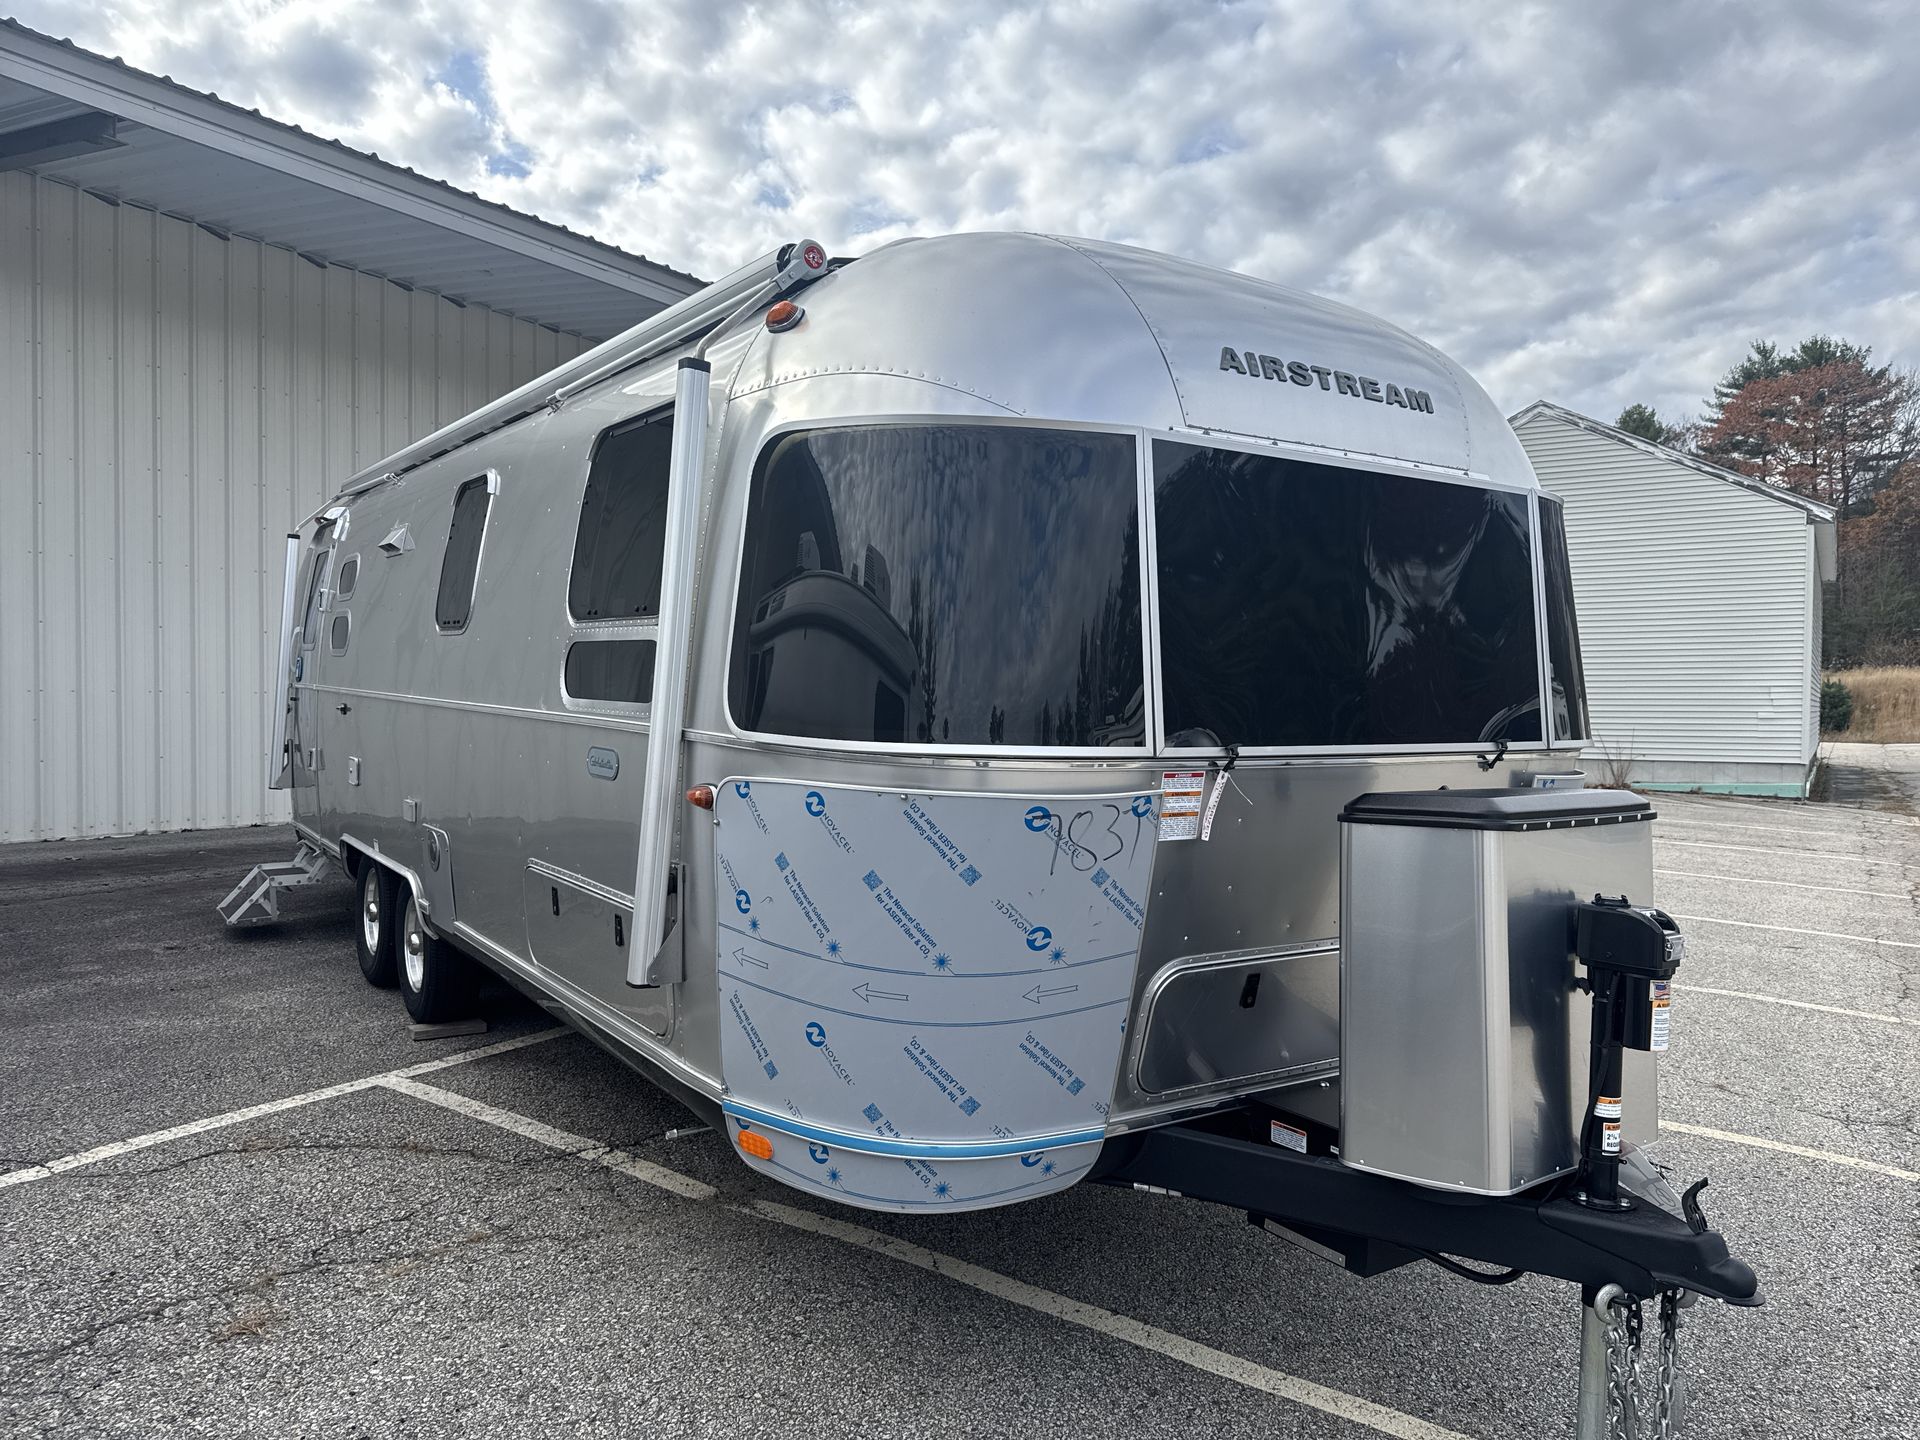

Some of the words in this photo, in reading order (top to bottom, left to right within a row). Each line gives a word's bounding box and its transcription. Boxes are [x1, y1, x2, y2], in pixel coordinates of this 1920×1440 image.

[1219, 346, 1435, 414] AIRSTREAM
[748, 795, 768, 835] NOVACEL
[903, 809, 927, 836] Solution
[924, 817, 940, 836] Fiber
[822, 813, 851, 853] NOVACEL
[937, 832, 959, 855] LASER
[1048, 825, 1081, 859] NOVACEL
[923, 834, 949, 860] Novacel
[957, 852, 968, 864] for
[947, 857, 959, 871] The
[789, 869, 798, 882] The
[797, 882, 814, 907] Novacel
[812, 907, 830, 934] Solution
[789, 884, 804, 907] LASER
[802, 905, 814, 924] Fiber
[1102, 887, 1110, 897] for
[1109, 894, 1126, 912] LASER
[1123, 908, 1135, 922] Fiber
[1110, 879, 1119, 891] The
[1117, 887, 1137, 907] Novacel
[875, 893, 885, 904] for
[883, 902, 903, 925] LASER
[900, 923, 916, 940] Fiber
[883, 887, 894, 900] The
[893, 899, 916, 924] Novacel
[913, 922, 937, 948] Solution
[994, 899, 1030, 935] NOVACEL
[903, 1046, 927, 1072] Solution
[924, 1053, 940, 1070] Fiber
[1019, 1042, 1040, 1063] Solution
[1038, 1044, 1053, 1059] Fiber
[823, 1043, 851, 1086] NOVACEL
[1037, 1060, 1059, 1079] Novacel
[1050, 1056, 1067, 1072] LASER
[1065, 1068, 1074, 1078] for
[923, 1069, 949, 1094] Novacel
[937, 1067, 959, 1088] LASER
[1056, 1075, 1067, 1086] The
[947, 1089, 959, 1104] The
[957, 1085, 968, 1096] for
[875, 1126, 885, 1136] for
[883, 1120, 894, 1134] The
